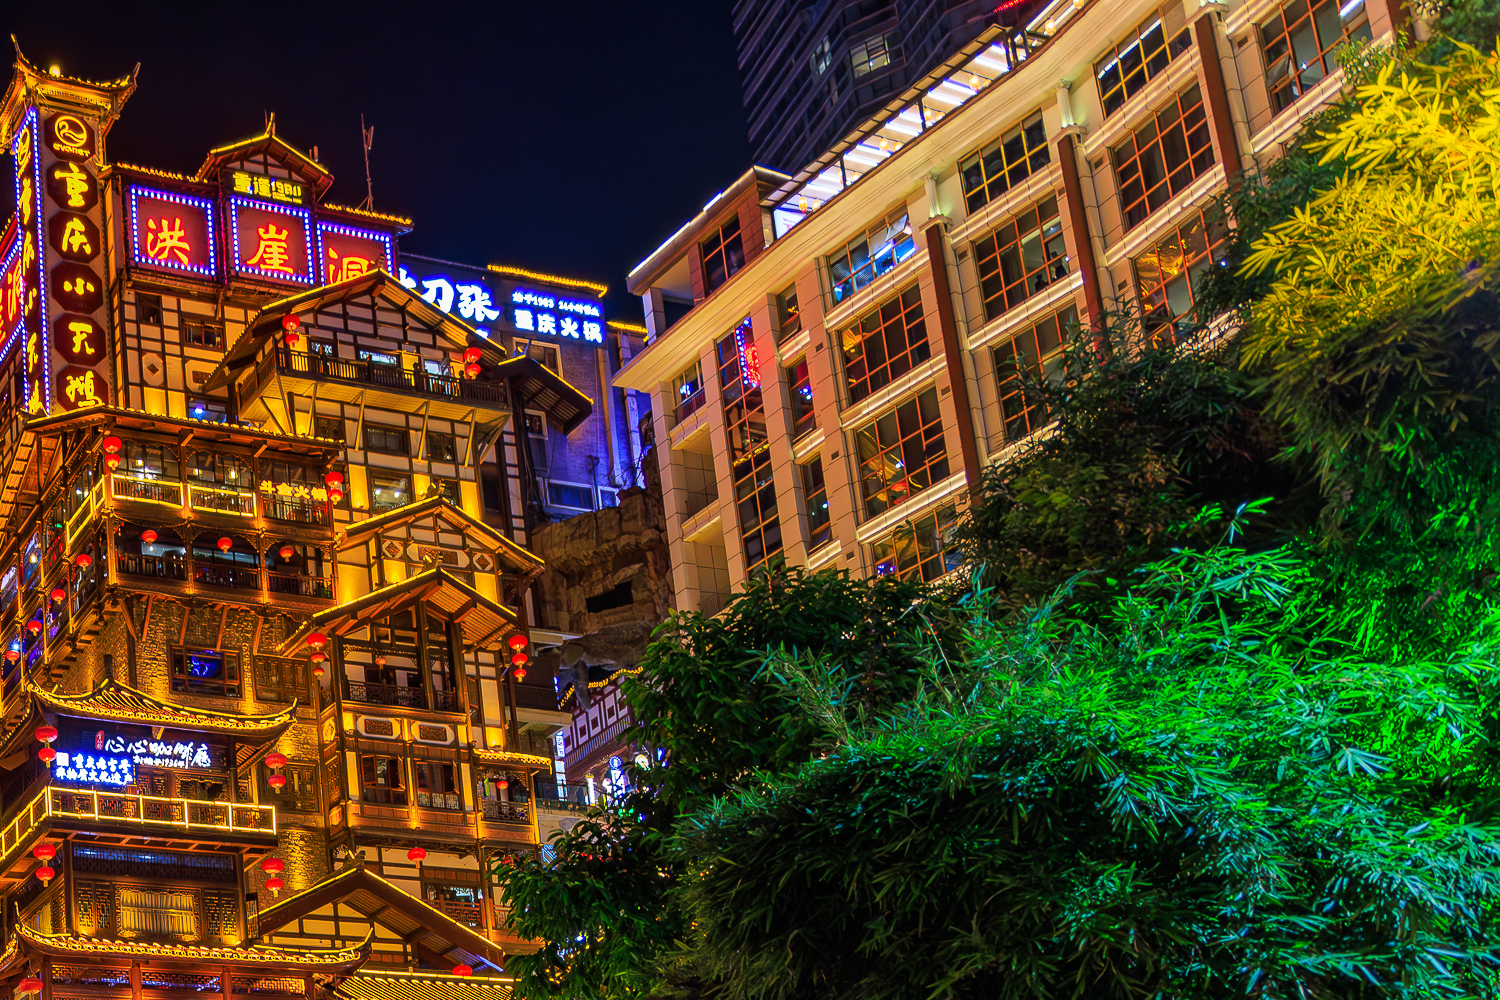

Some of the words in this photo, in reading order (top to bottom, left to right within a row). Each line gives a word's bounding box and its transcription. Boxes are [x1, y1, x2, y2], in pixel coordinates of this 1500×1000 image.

[514, 309, 603, 343] 重庆火锅
[260, 480, 328, 502] 斗金火锅
